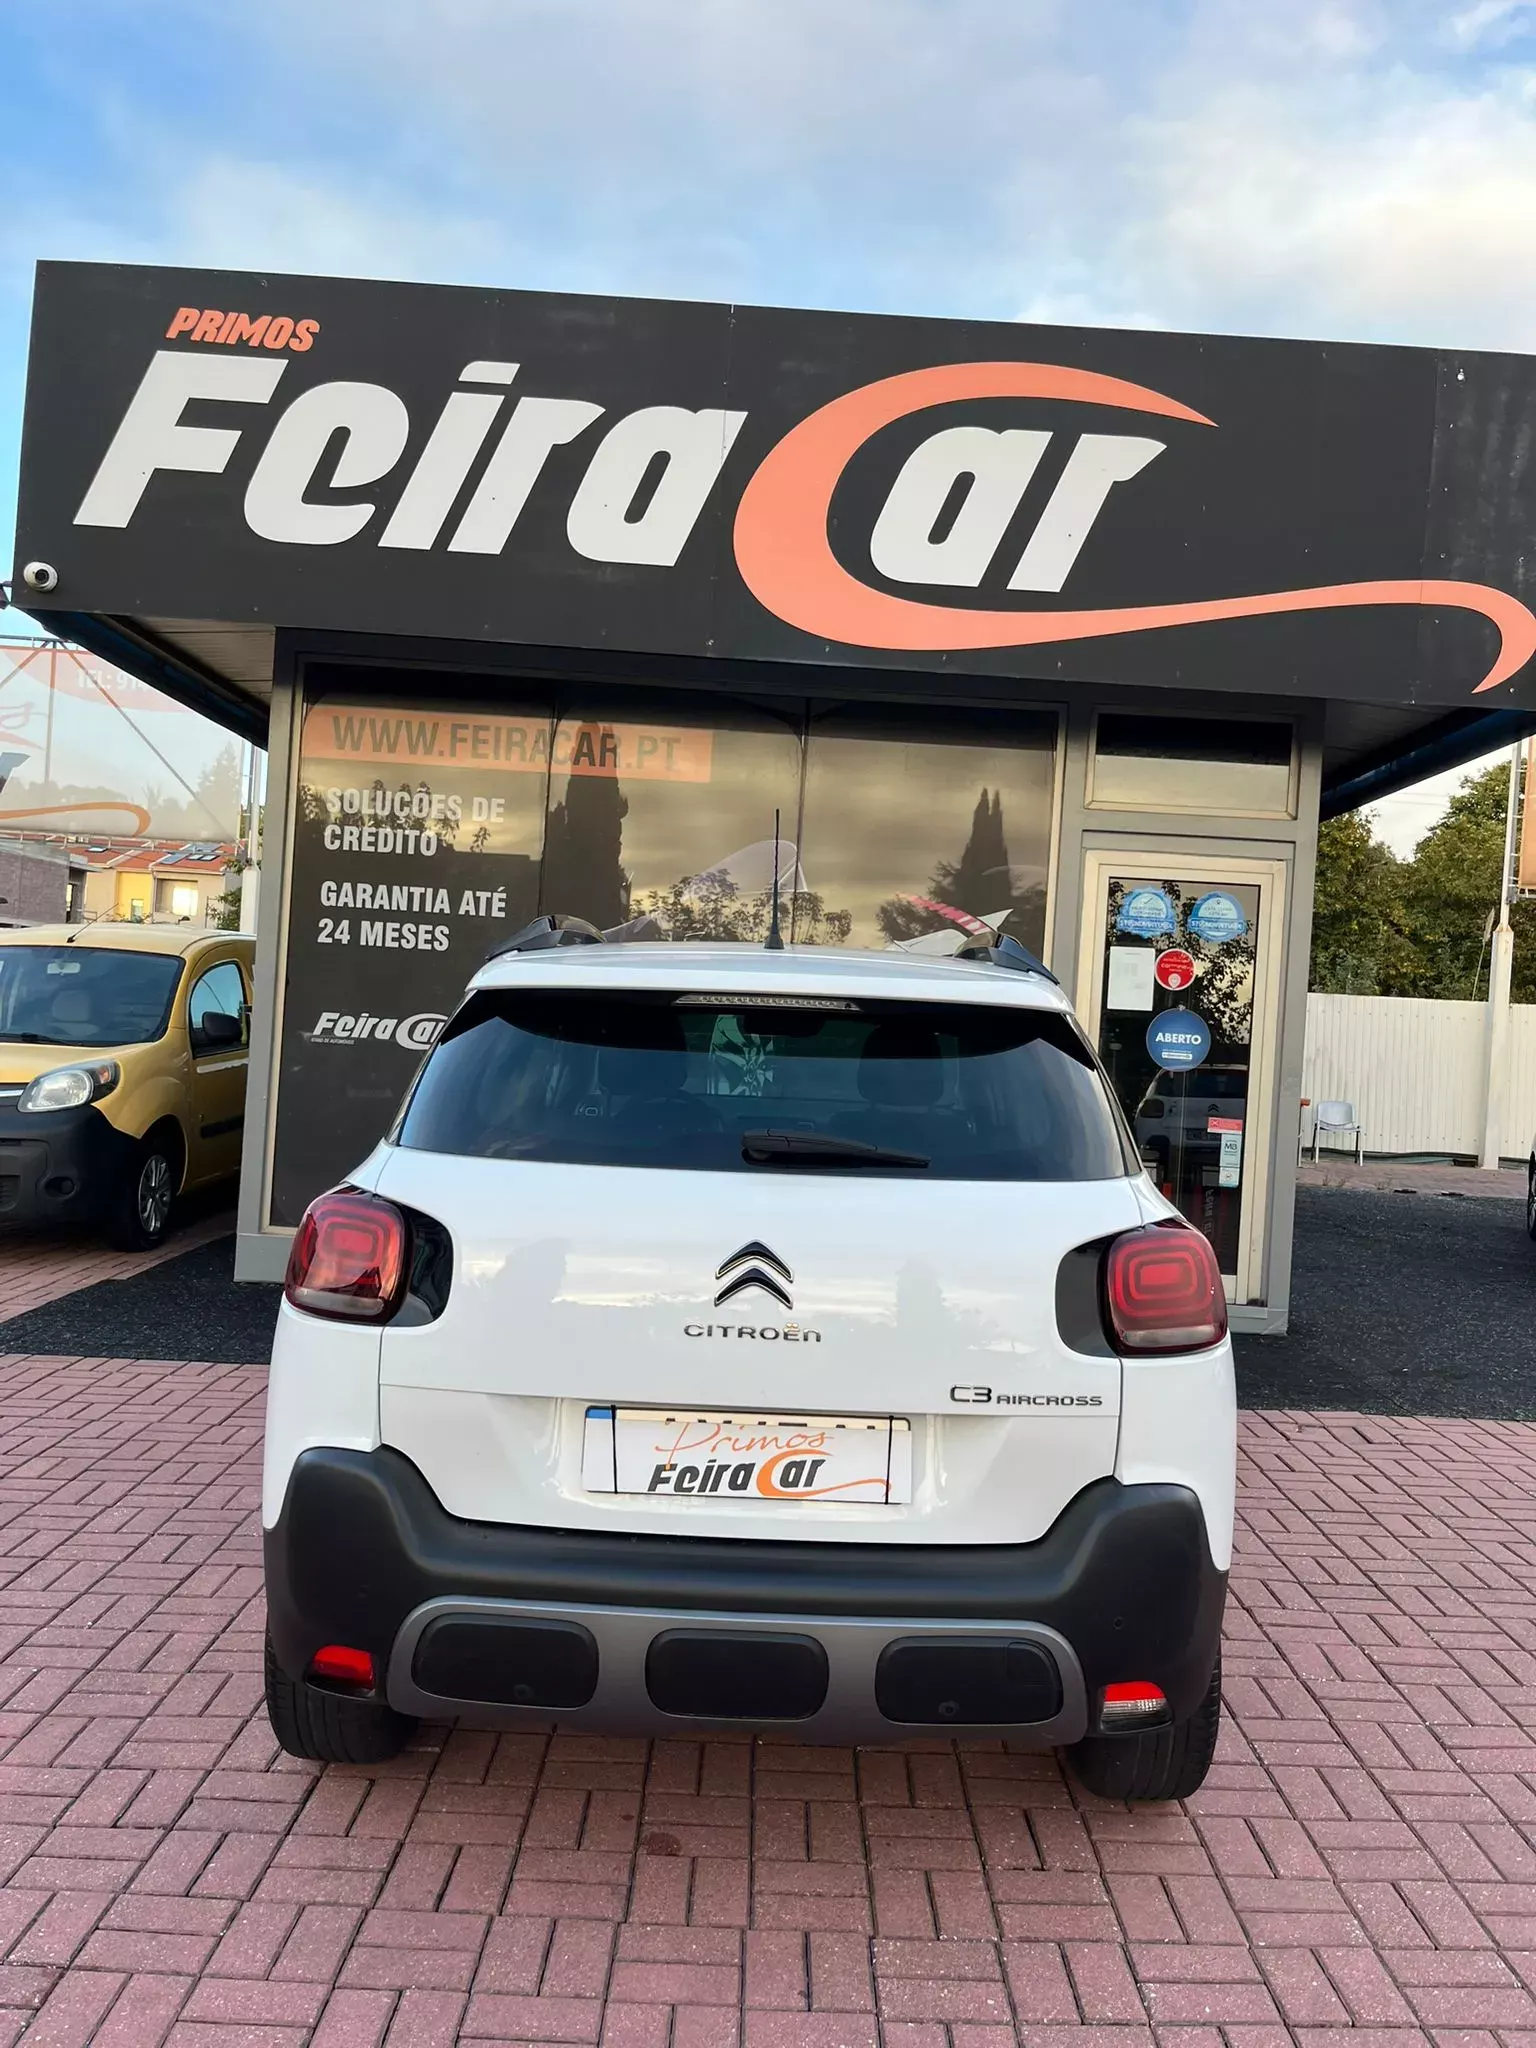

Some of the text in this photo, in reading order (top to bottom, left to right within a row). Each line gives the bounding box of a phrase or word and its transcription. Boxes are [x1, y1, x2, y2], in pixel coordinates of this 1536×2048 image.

[166, 307, 320, 351] PRIMOS
[73, 349, 1221, 651] FeiraCar
[332, 715, 682, 773] WWW.FEIRACAR.PT
[326, 786, 506, 824] SOLUÇÕES DE
[320, 880, 507, 918] GARANTIA ATÉ
[317, 918, 450, 952] 24 MESES
[1155, 1032, 1202, 1045] ABERTO
[950, 1384, 1103, 1408] C3 AIRCROSS
[655, 1421, 835, 1471] Primos
[647, 1449, 835, 1499] FeiraCar
